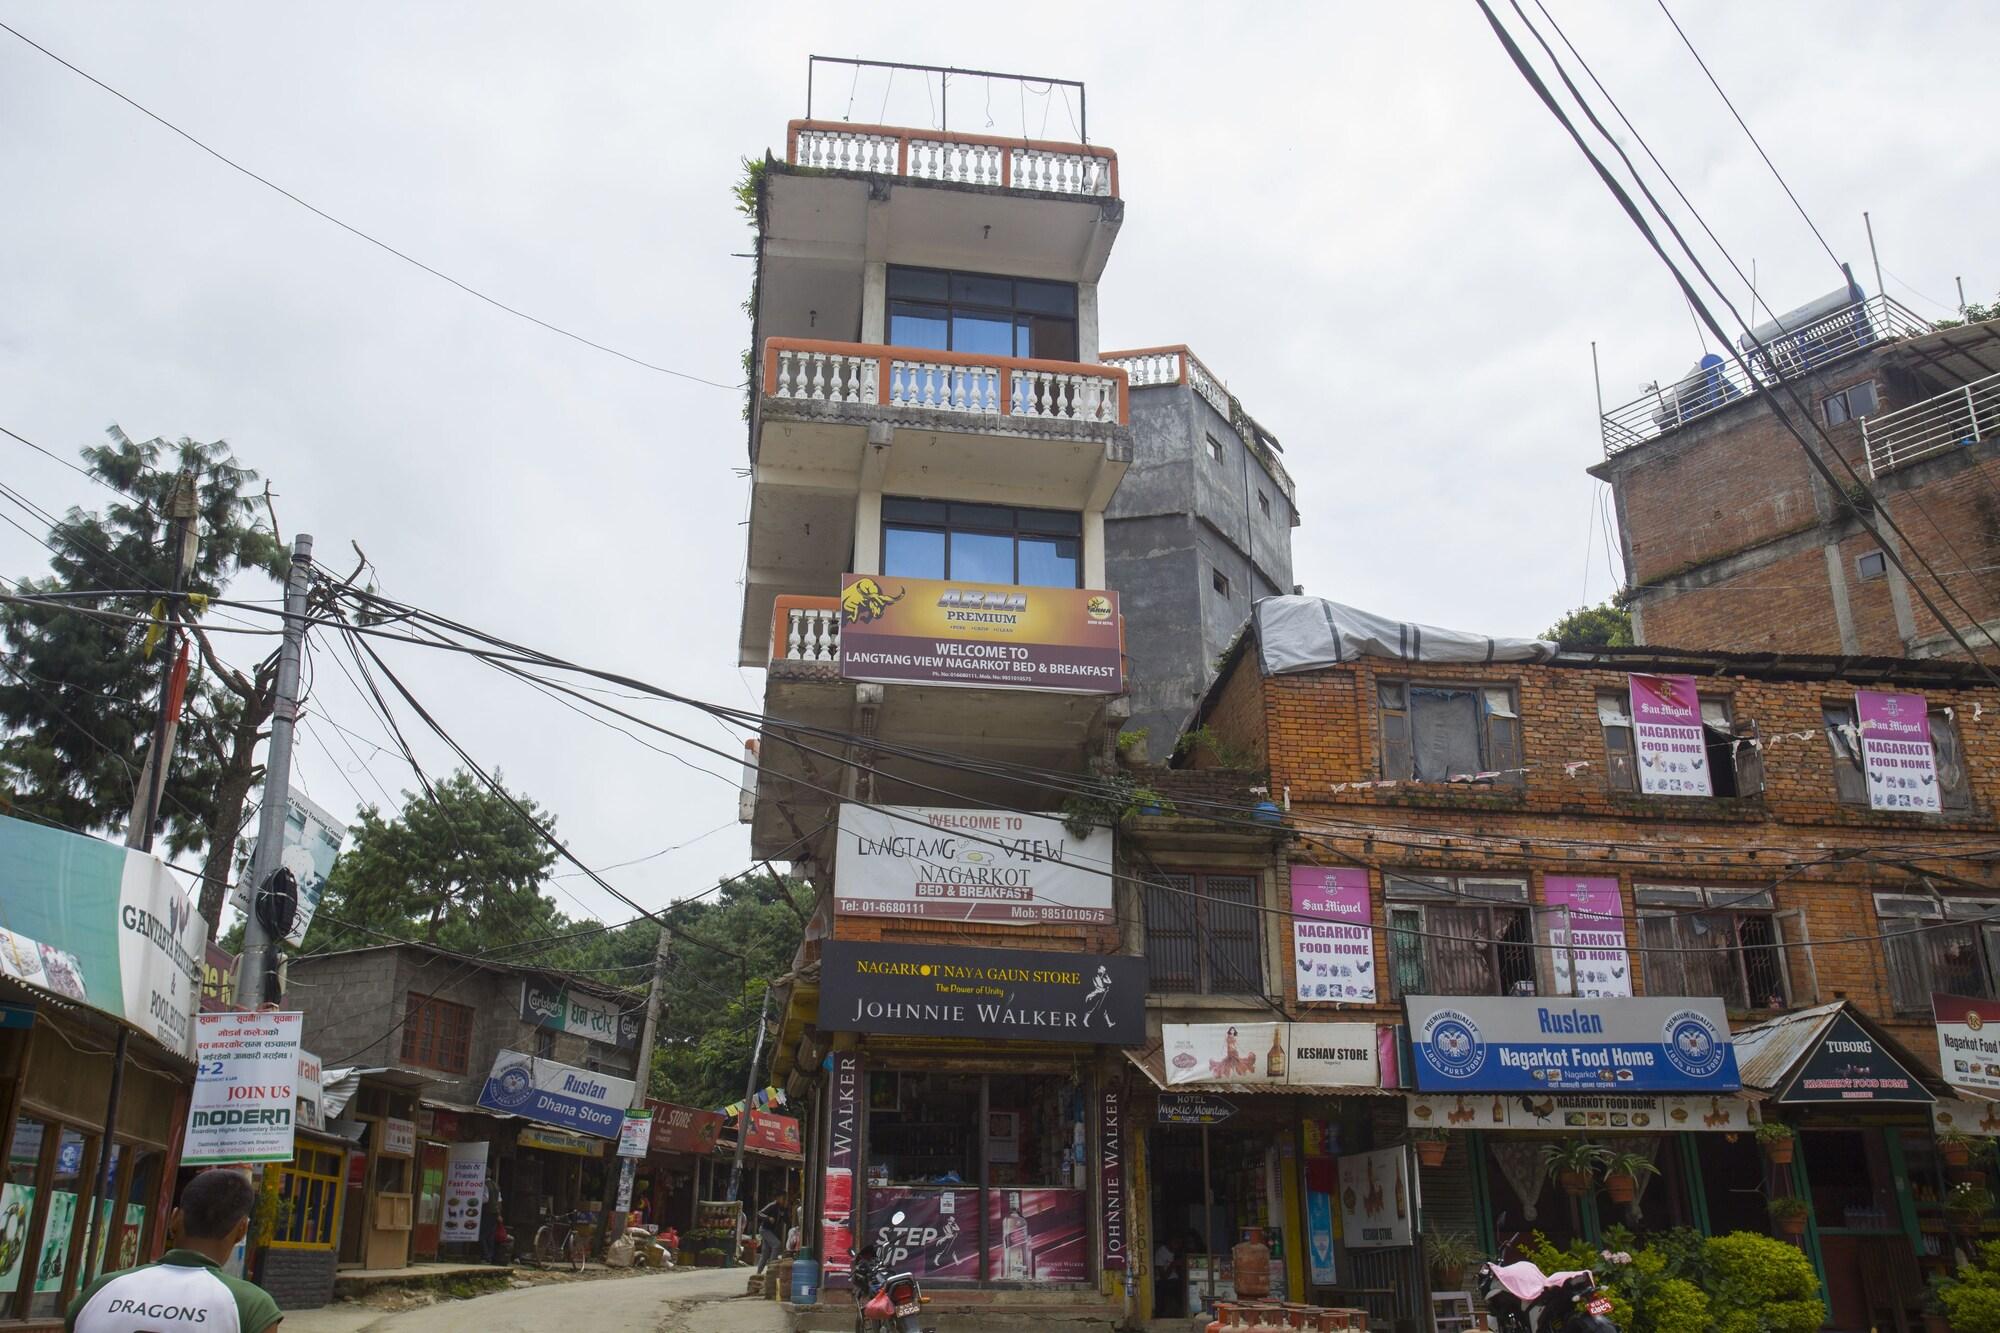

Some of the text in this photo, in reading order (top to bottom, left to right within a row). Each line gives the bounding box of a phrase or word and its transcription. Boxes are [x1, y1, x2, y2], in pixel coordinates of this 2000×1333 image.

[947, 611, 1016, 624] PREMIUM
[936, 643, 1029, 660] WELCOME TO
[846, 652, 1115, 677] LANGTANG VIEW NAGARKOT BED & BREAKFAST
[1641, 703, 1693, 718] San Miguel
[1640, 726, 1702, 740] NAGARKOT
[1871, 719, 1921, 733] San Miguel
[1642, 741, 1702, 754] FOOD HOME
[1868, 741, 1930, 756] NAGARKOT
[1870, 757, 1931, 769] FOOD HOME
[308, 810, 328, 831] Training
[928, 814, 1022, 830] WELCOME TO
[858, 836, 1065, 862] LANGTANG VIEW
[919, 865, 1031, 887] NAGARKOT
[918, 885, 1030, 899] BED & BREAKFAST
[841, 900, 860, 912] Tel:
[862, 902, 924, 914] 01-6680111
[1011, 907, 1038, 919] Mob:
[1302, 899, 1361, 915] San Miguel
[1298, 925, 1370, 940] NAGARKOT
[1299, 942, 1369, 955] FOOD HOME
[1589, 951, 1622, 961] HOME
[944, 967, 983, 979] NAYA
[987, 968, 1030, 982] GAUN
[1033, 970, 1081, 985] STORE
[936, 983, 1004, 998] The Power of Unity
[150, 990, 169, 1027] POOL
[528, 988, 564, 1017] Carlsberg
[570, 1003, 588, 1026] धन
[852, 998, 1077, 1027] JOHNNIE WALKER
[1424, 1011, 1479, 1033] PREMIUM QUALITY
[1538, 1007, 1603, 1034] Ruslan
[1665, 1011, 1716, 1033] PREMIUM QUALITY
[1826, 1041, 1872, 1053] TUBORG
[1944, 1034, 1998, 1054] Nagarkot Food
[1297, 1048, 1368, 1061] KESHAV STORE
[1426, 1049, 1483, 1075] 100% PURE VODKA
[1499, 1047, 1654, 1070] Nagarkot Food Home
[1668, 1049, 1722, 1075] 100% PURE VODKA
[198, 1062, 223, 1075] +2
[1564, 1071, 1597, 1080] Nagarkot
[227, 1086, 290, 1101] JOIN US
[563, 1074, 608, 1100] Ruslan
[1853, 1079, 1879, 1089] FOOD
[537, 1096, 613, 1126] Dhana Store
[833, 1058, 856, 1157] WALKER
[1557, 1097, 1656, 1110] NAGARKOT FOOD HOME
[192, 1108, 291, 1128] MODERN
[667, 1110, 692, 1129] STORE
[1104, 1093, 1125, 1263] JOHNNIE WALKER
[876, 1227, 938, 1246] STEP
[108, 1300, 208, 1323] DRAGONS
